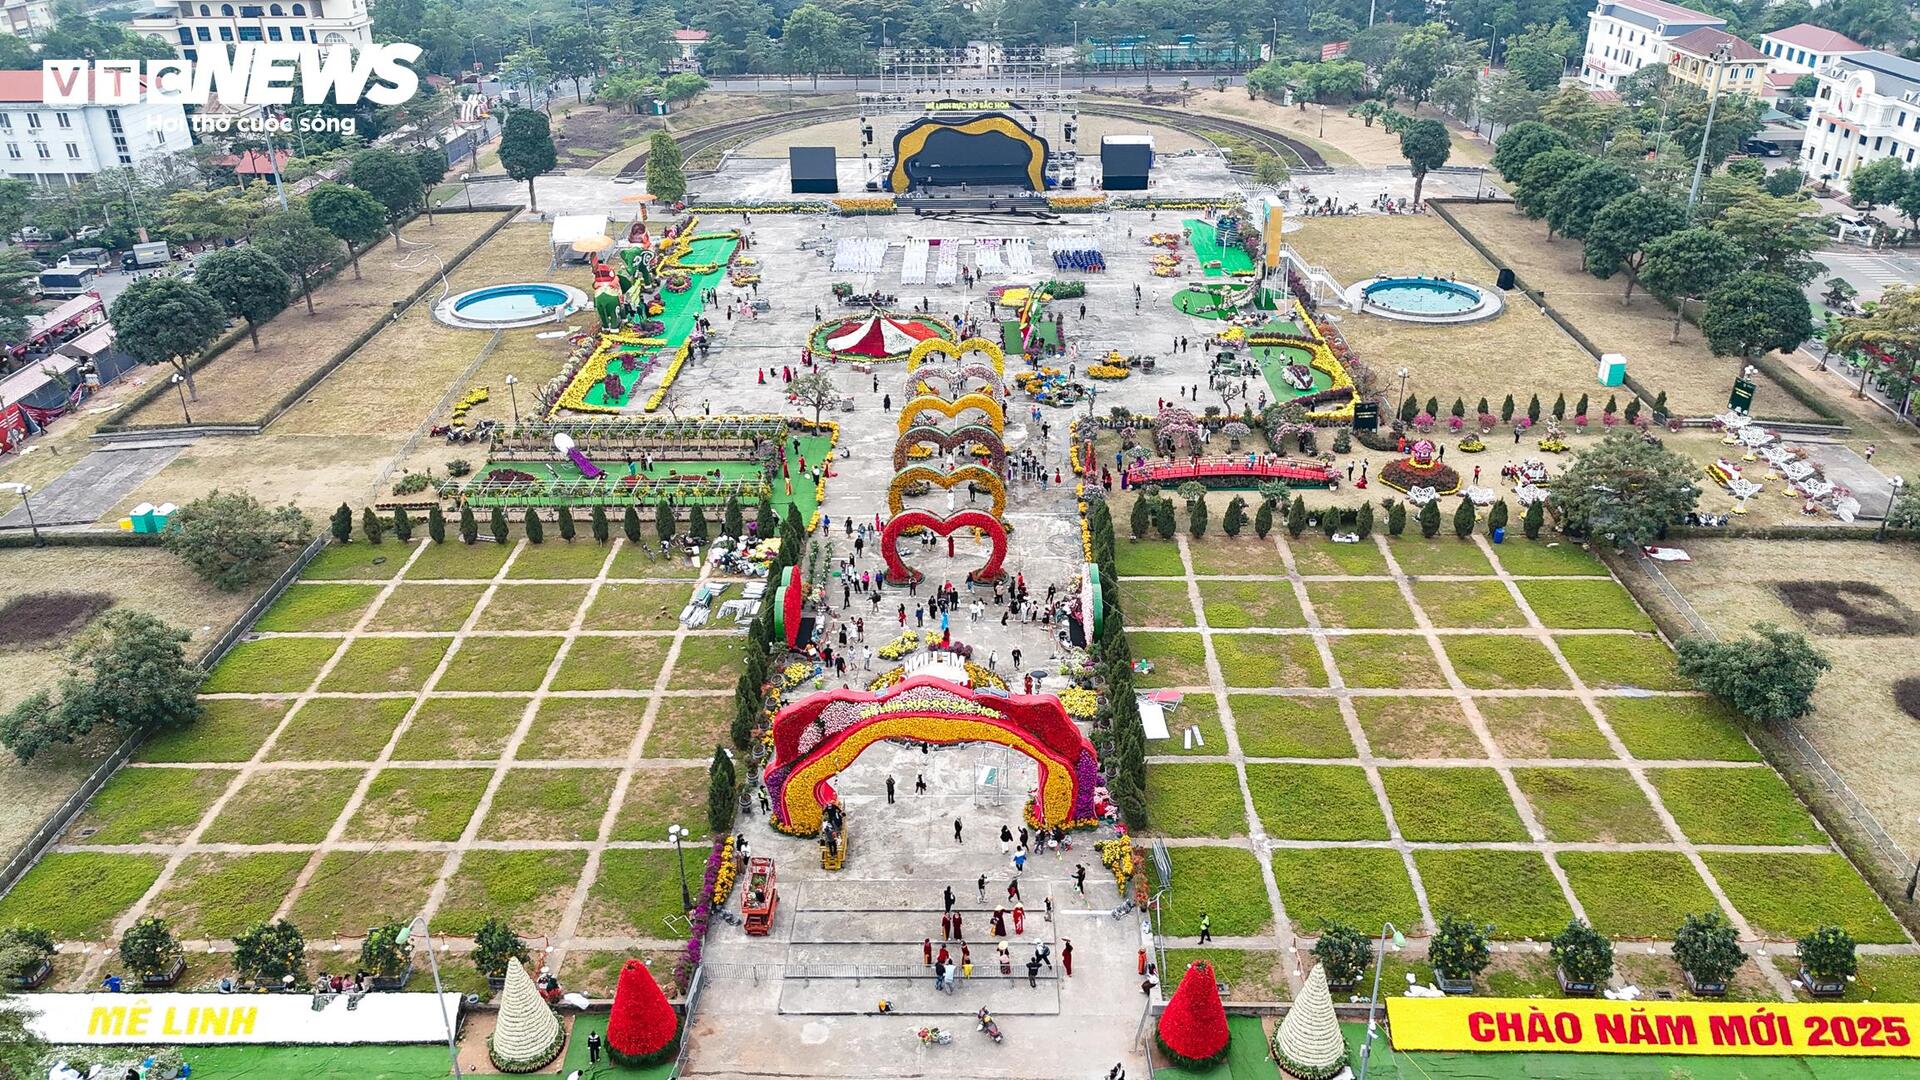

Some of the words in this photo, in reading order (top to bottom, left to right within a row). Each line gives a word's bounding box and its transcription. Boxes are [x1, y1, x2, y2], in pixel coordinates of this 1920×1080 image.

[88, 999, 152, 1036] MÊ
[161, 1006, 258, 1036] LINH
[1468, 1005, 1582, 1044] CHÀO
[1594, 1007, 1698, 1045] NĂM
[1709, 1007, 1793, 1046] MỚI
[1804, 1016, 1911, 1047] 2025
